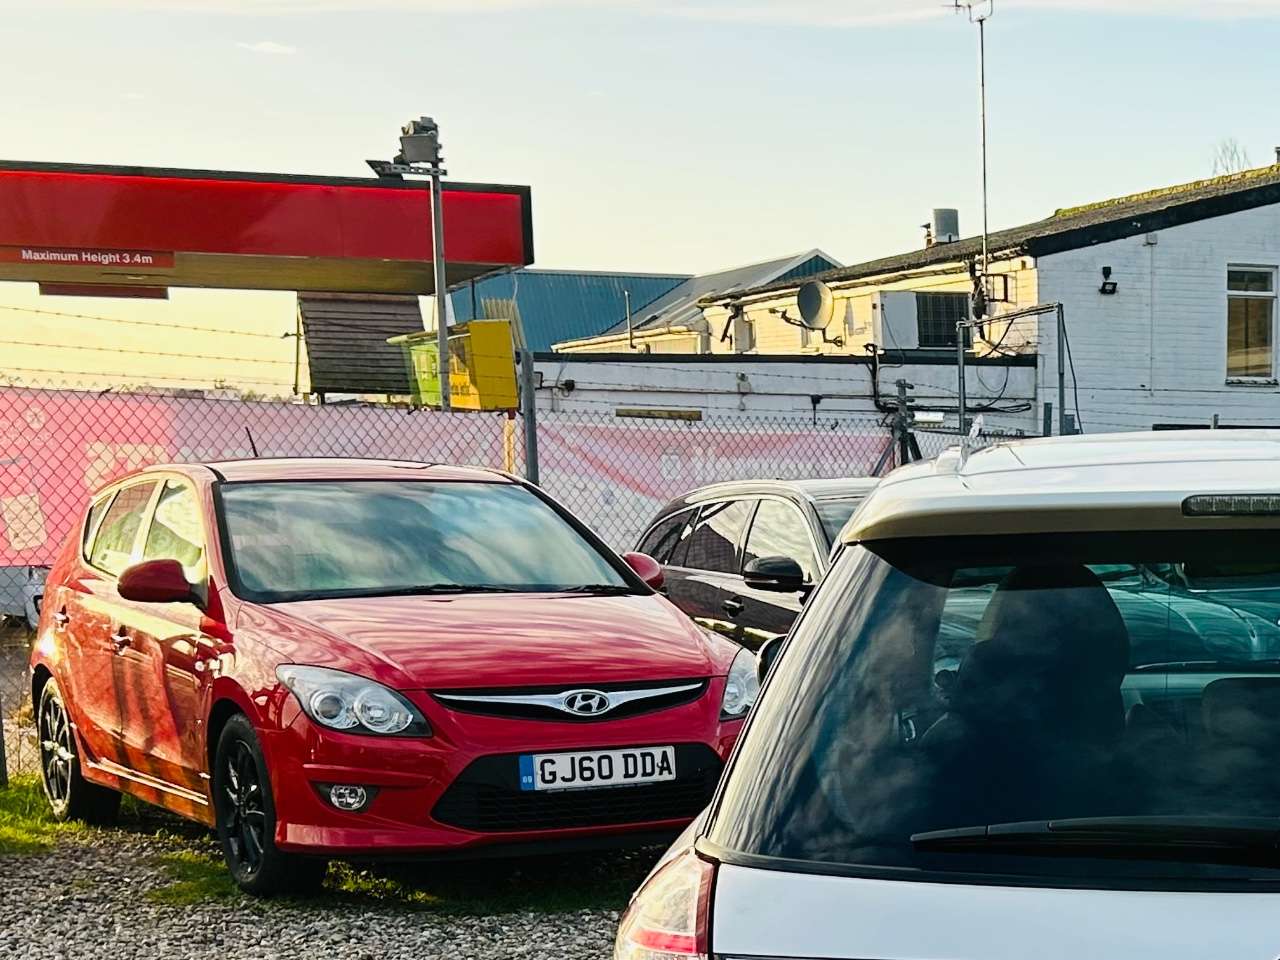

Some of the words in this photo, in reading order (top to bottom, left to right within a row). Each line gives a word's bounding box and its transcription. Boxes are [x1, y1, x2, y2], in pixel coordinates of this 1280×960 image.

[21, 249, 79, 262] Maximum
[82, 252, 120, 265] Height
[122, 253, 153, 264] 3.4m
[540, 754, 614, 784] GJ60
[622, 750, 673, 779] DDA
